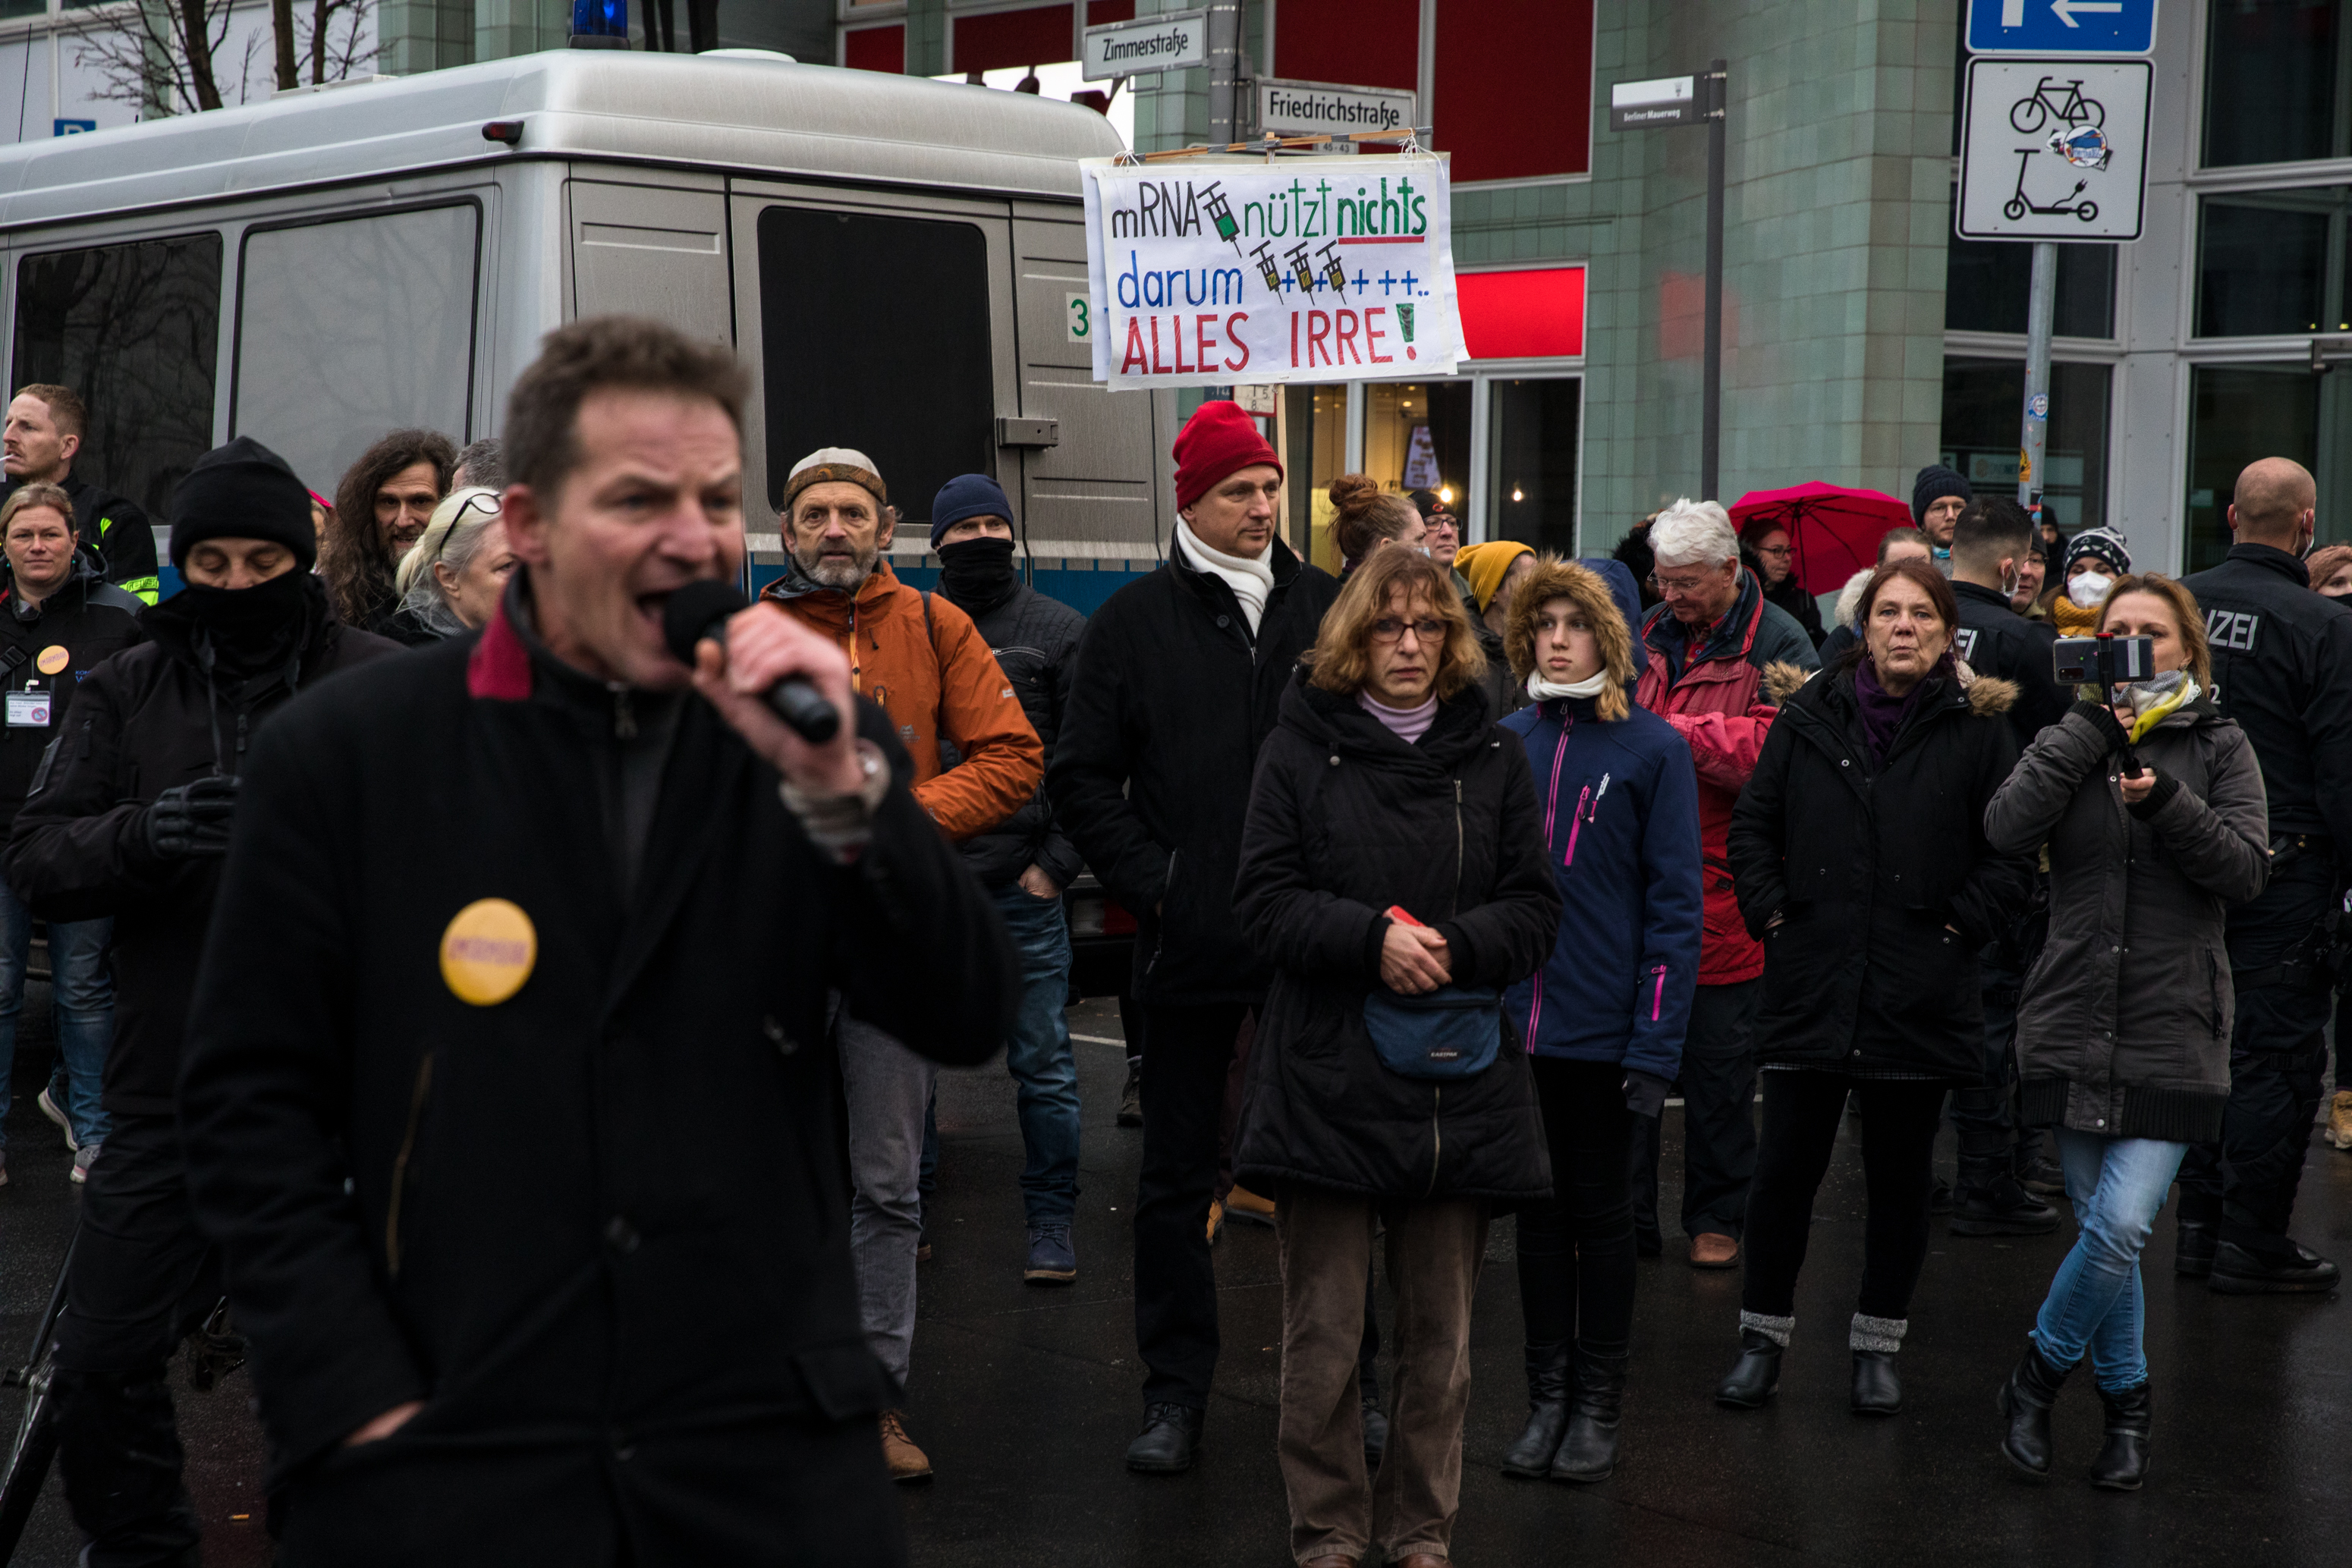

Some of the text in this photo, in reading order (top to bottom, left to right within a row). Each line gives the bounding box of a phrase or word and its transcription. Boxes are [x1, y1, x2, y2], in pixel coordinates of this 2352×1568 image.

[1103, 27, 1188, 61] Zimmerstraße
[1270, 91, 1400, 130] Friedrichstraße
[1623, 108, 1681, 122] Berliner Mauerweg
[1112, 177, 1427, 238] mRNA nützt nichts
[1118, 250, 1244, 308] darum
[1121, 303, 1417, 375] ALLES IRRE!
